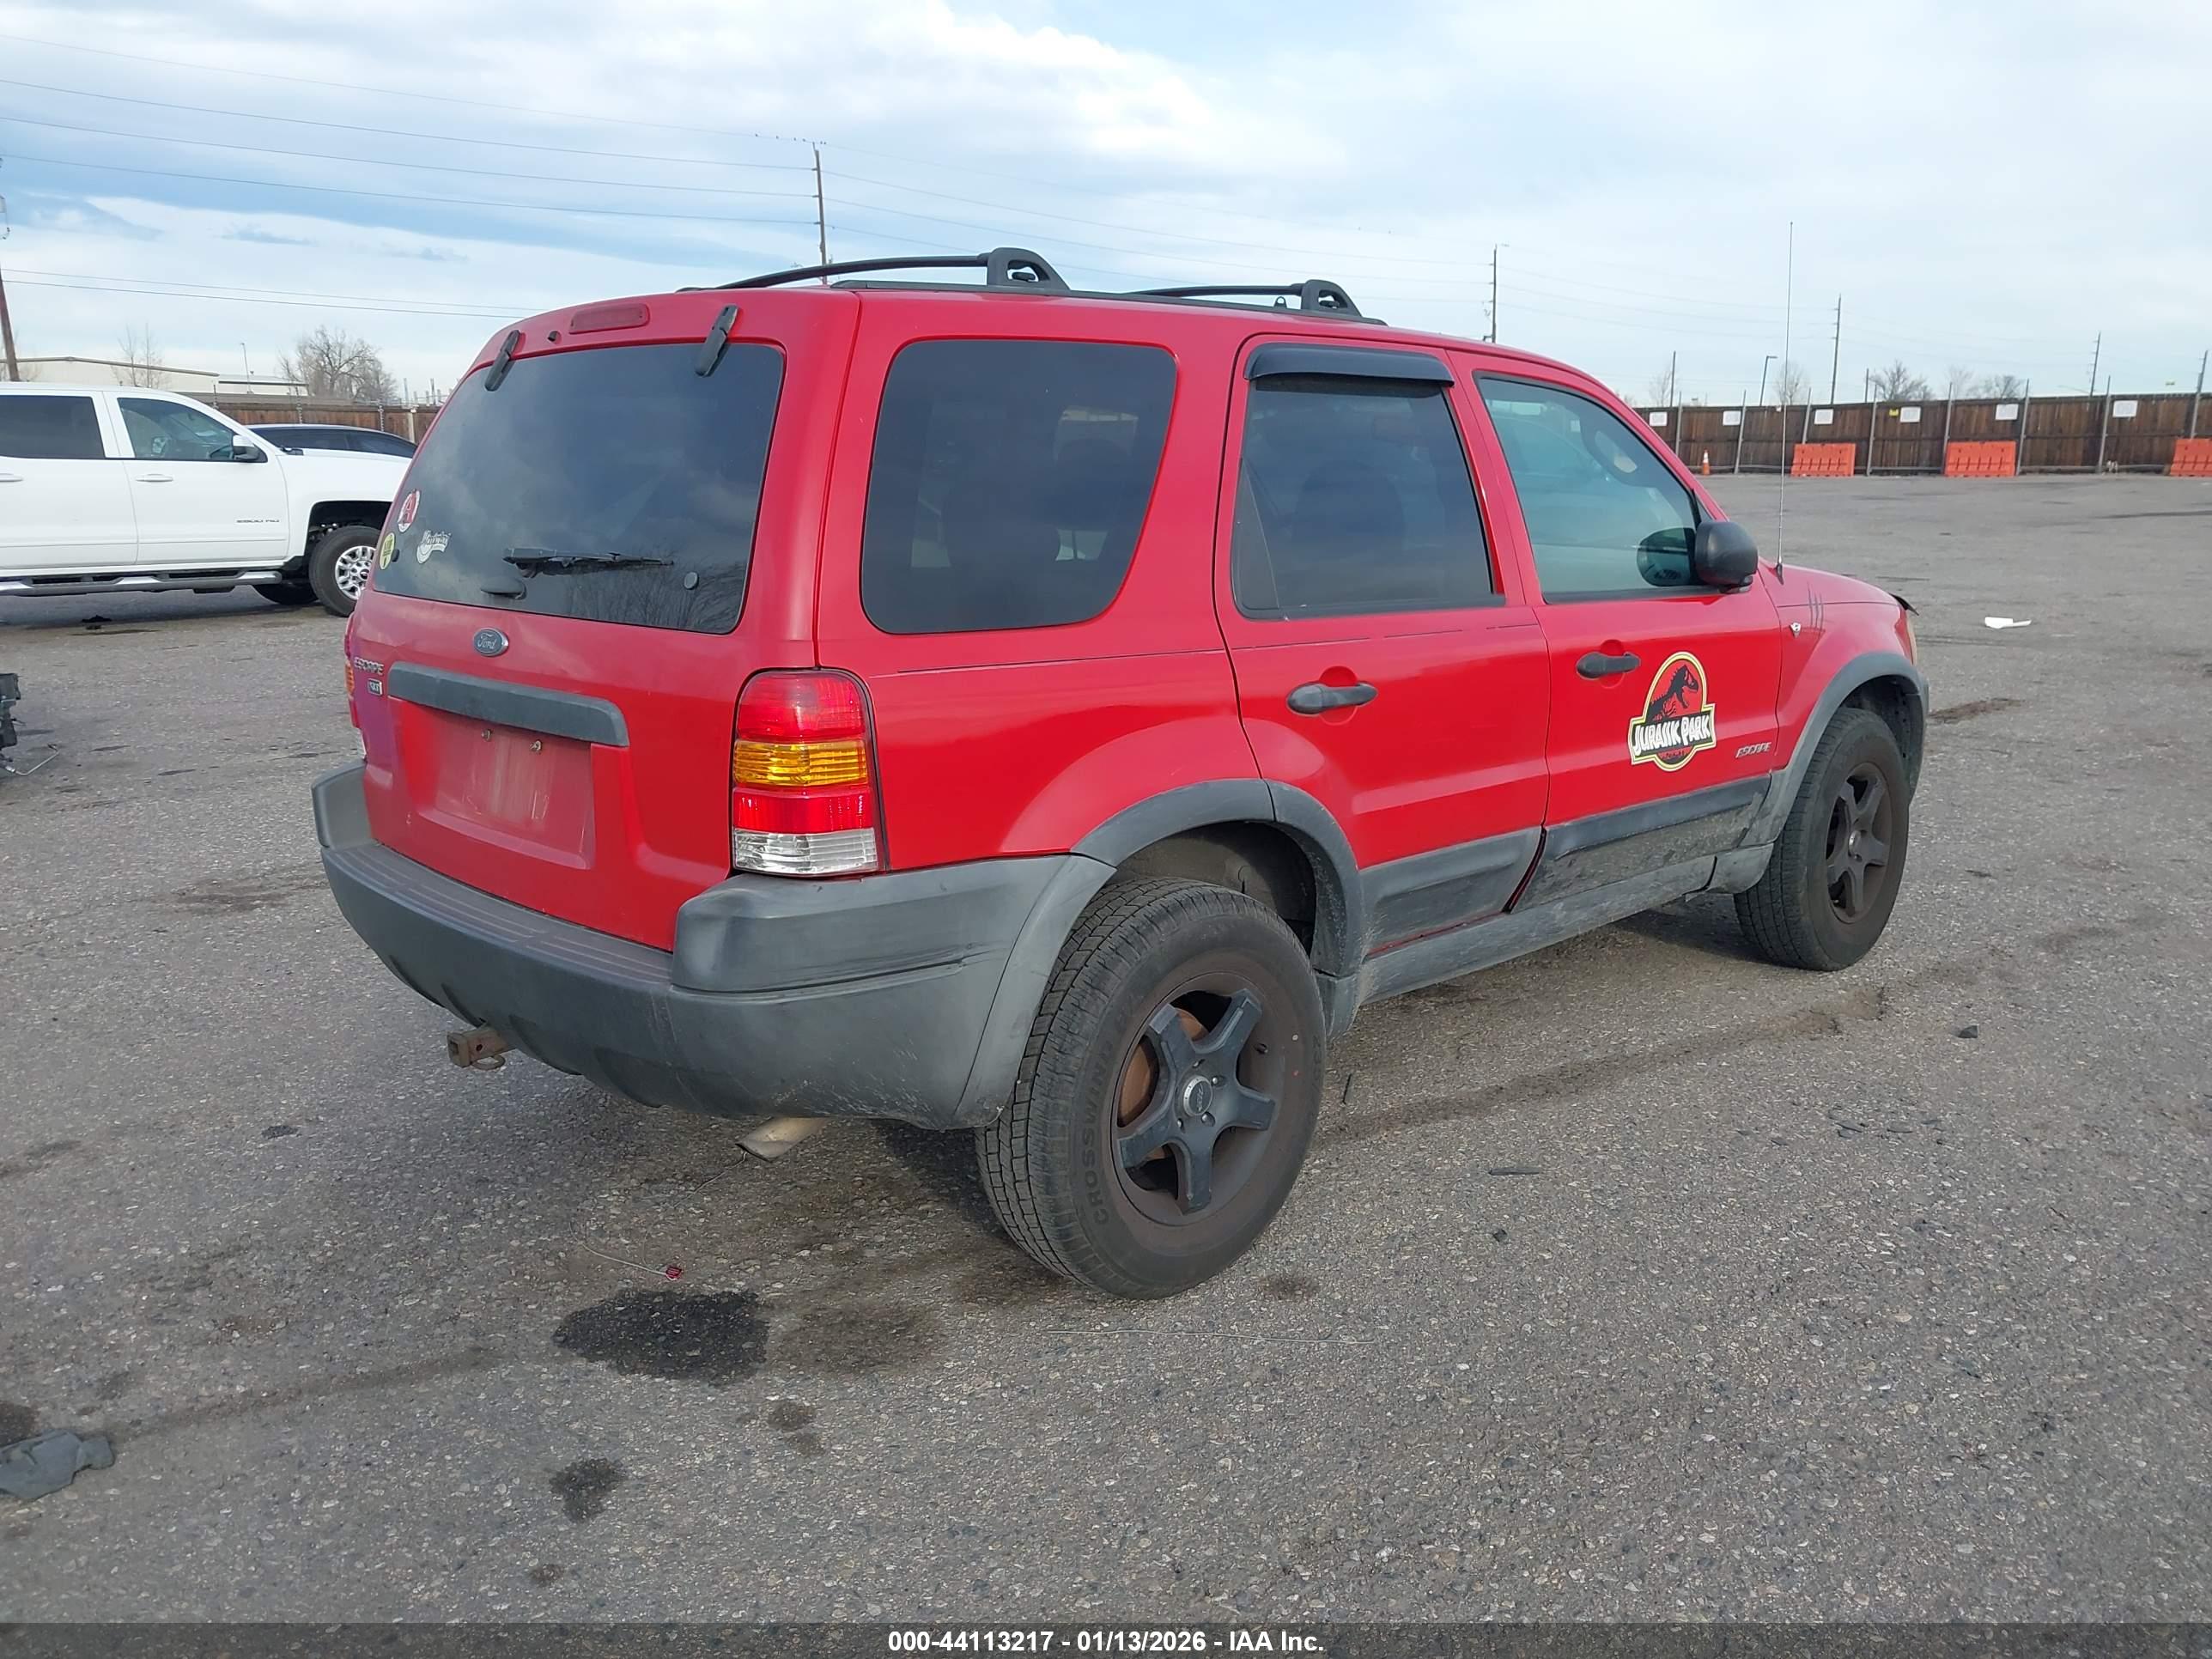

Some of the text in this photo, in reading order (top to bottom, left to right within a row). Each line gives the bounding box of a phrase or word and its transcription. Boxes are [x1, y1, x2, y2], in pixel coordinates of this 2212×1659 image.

[477, 632, 497, 649] Ford
[354, 656, 384, 676] ESCAPE
[1680, 714, 1711, 745] PARK
[1735, 742, 1772, 759] ESCAPE
